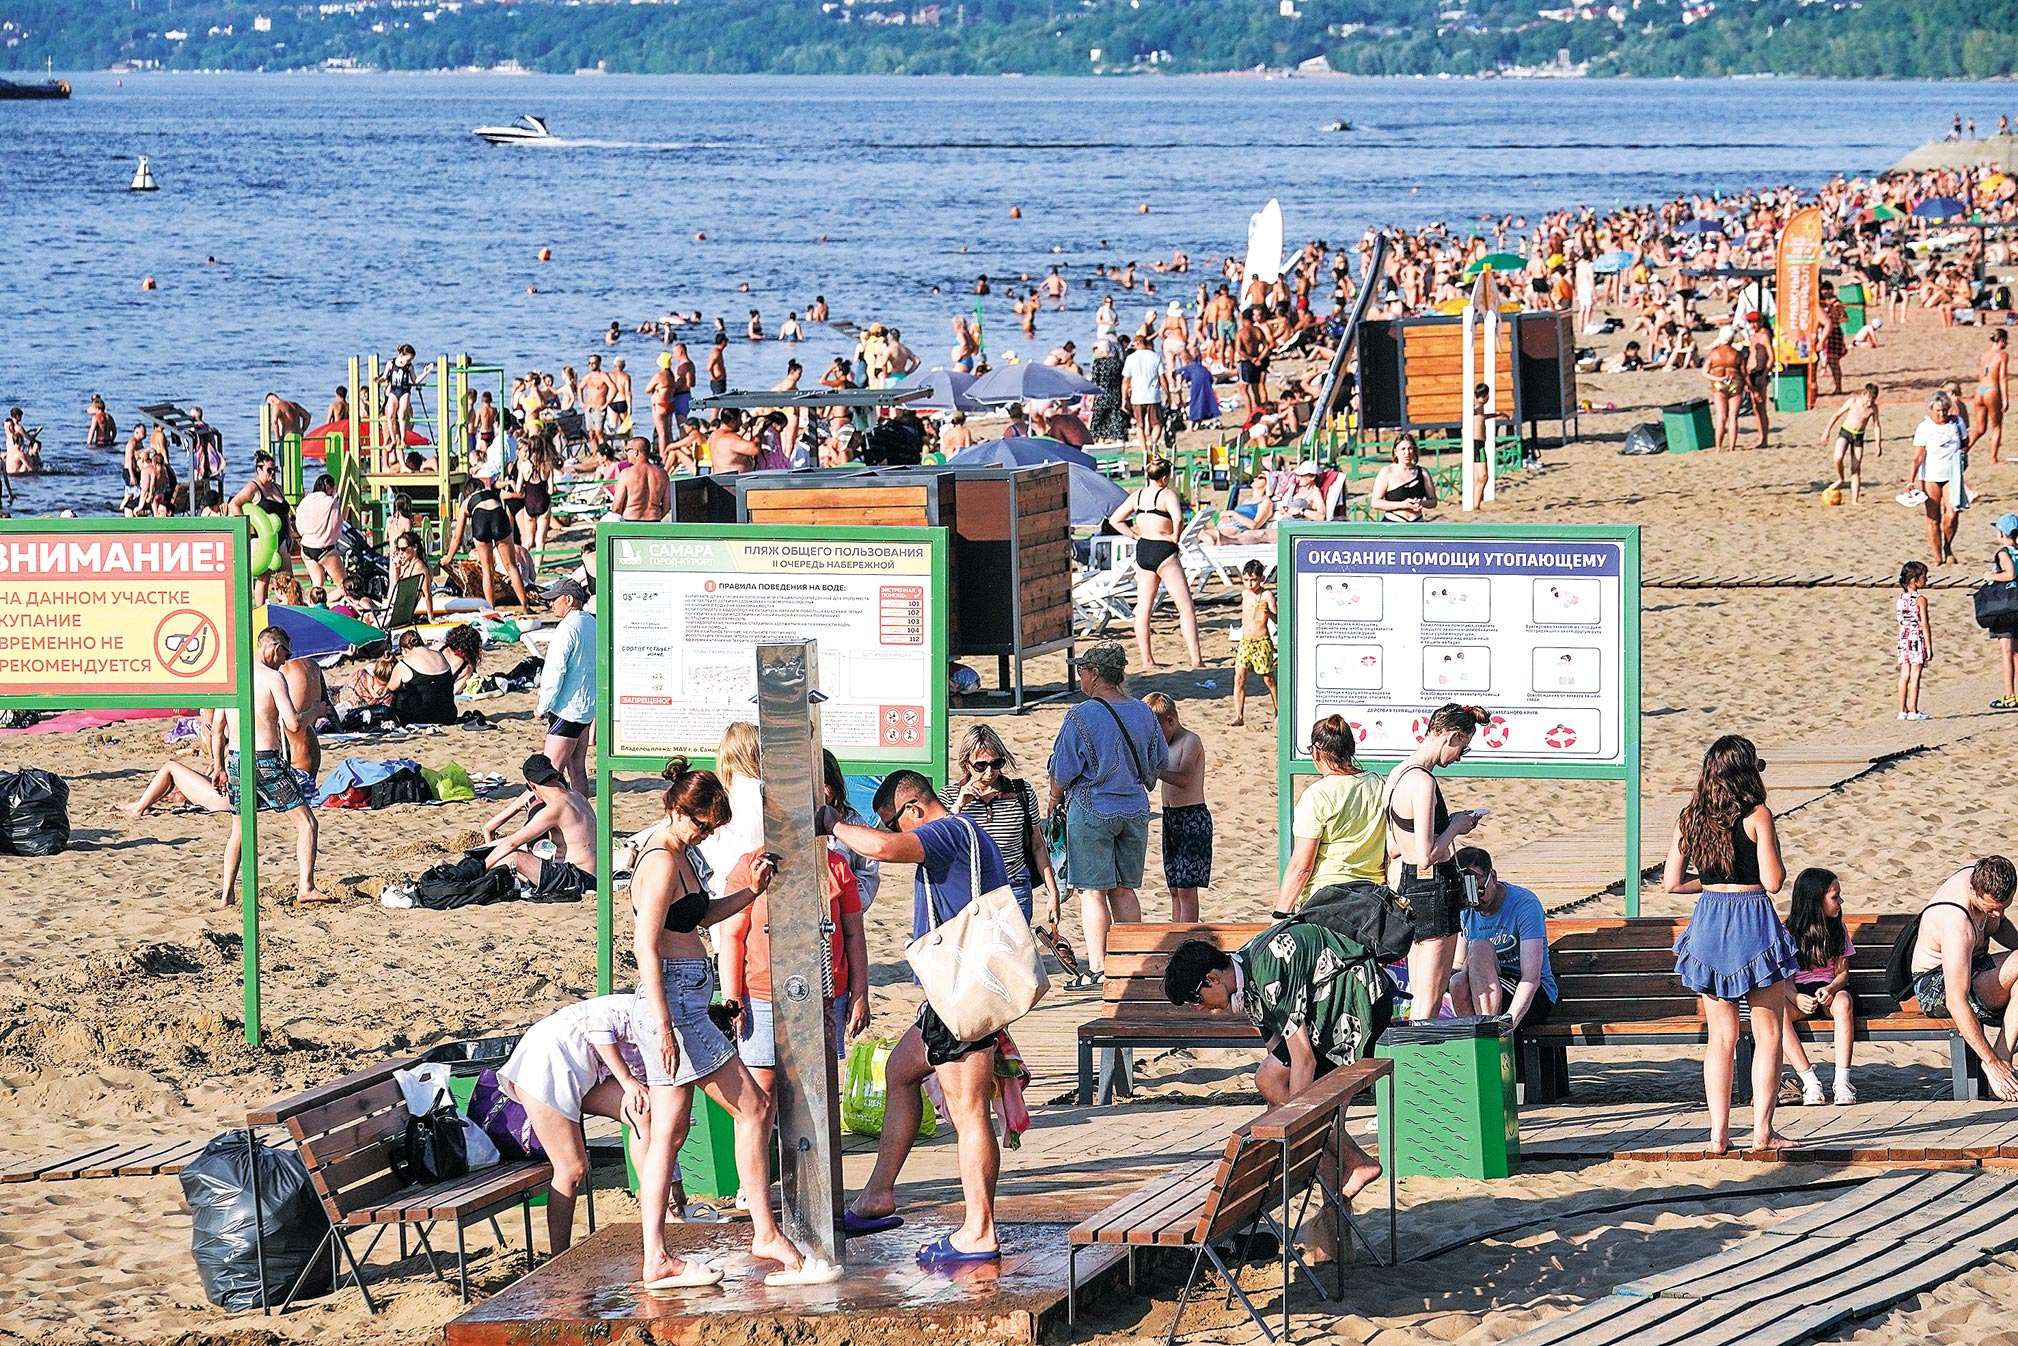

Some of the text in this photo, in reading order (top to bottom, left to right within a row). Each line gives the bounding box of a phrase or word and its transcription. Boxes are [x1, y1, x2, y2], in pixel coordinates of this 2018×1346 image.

[648, 544, 714, 557] САМАРА
[744, 546, 924, 558] ПЛЯЖ ОБЩЕГО ПОЛЬЗОВАНИЯ
[650, 558, 713, 567] ГОРОД-КУРОРТ
[780, 560, 824, 570] ОЧЕРЕДЬ
[826, 560, 895, 569] НАБЕРЕЖНОЙ
[1308, 550, 1607, 570] ОКАЗАНИЕ ПОМОЩИ УТОПАЮЩЕМУ
[26, 591, 106, 607] ДАННОМ
[112, 590, 190, 605] УЧАСТКЕ
[0, 614, 82, 627] КУПАНИЕ
[0, 636, 124, 650] ВРЕМЕННО НЕ
[0, 659, 151, 674] РЕКОМЕНДУЕТСЯ
